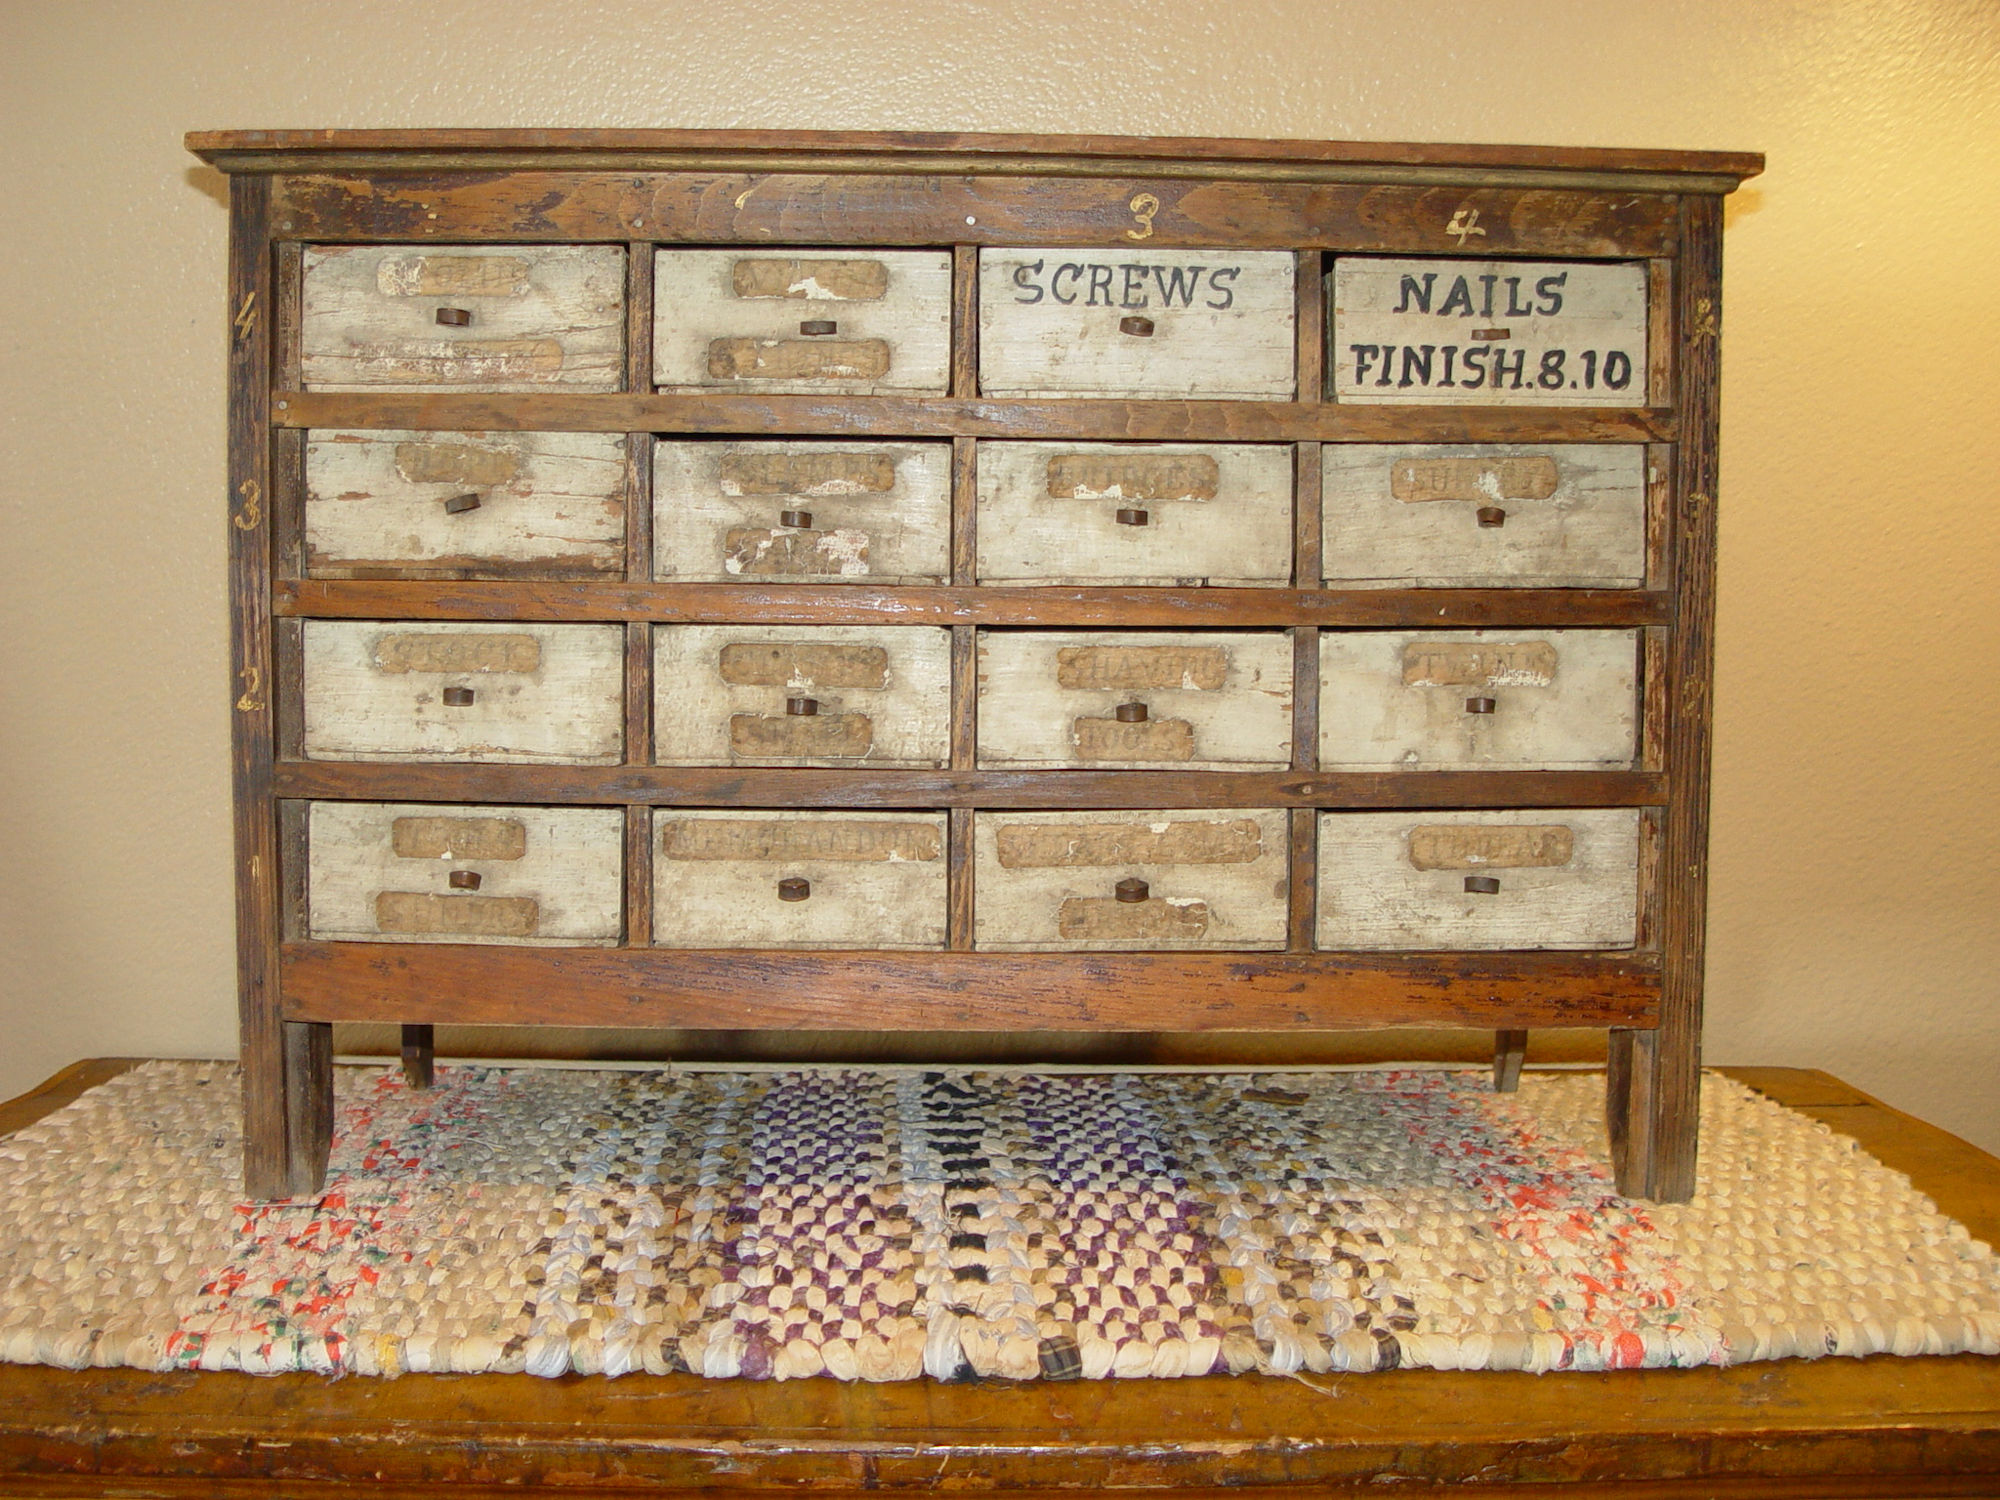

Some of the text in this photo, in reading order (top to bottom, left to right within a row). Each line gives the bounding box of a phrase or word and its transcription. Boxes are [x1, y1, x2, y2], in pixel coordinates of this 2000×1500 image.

[1126, 192, 1160, 241] 3
[1444, 207, 1487, 248] 4
[1012, 258, 1241, 310] SCREWS
[1392, 271, 1568, 318] NAILS
[234, 478, 262, 532] 3
[235, 666, 266, 712] 2
